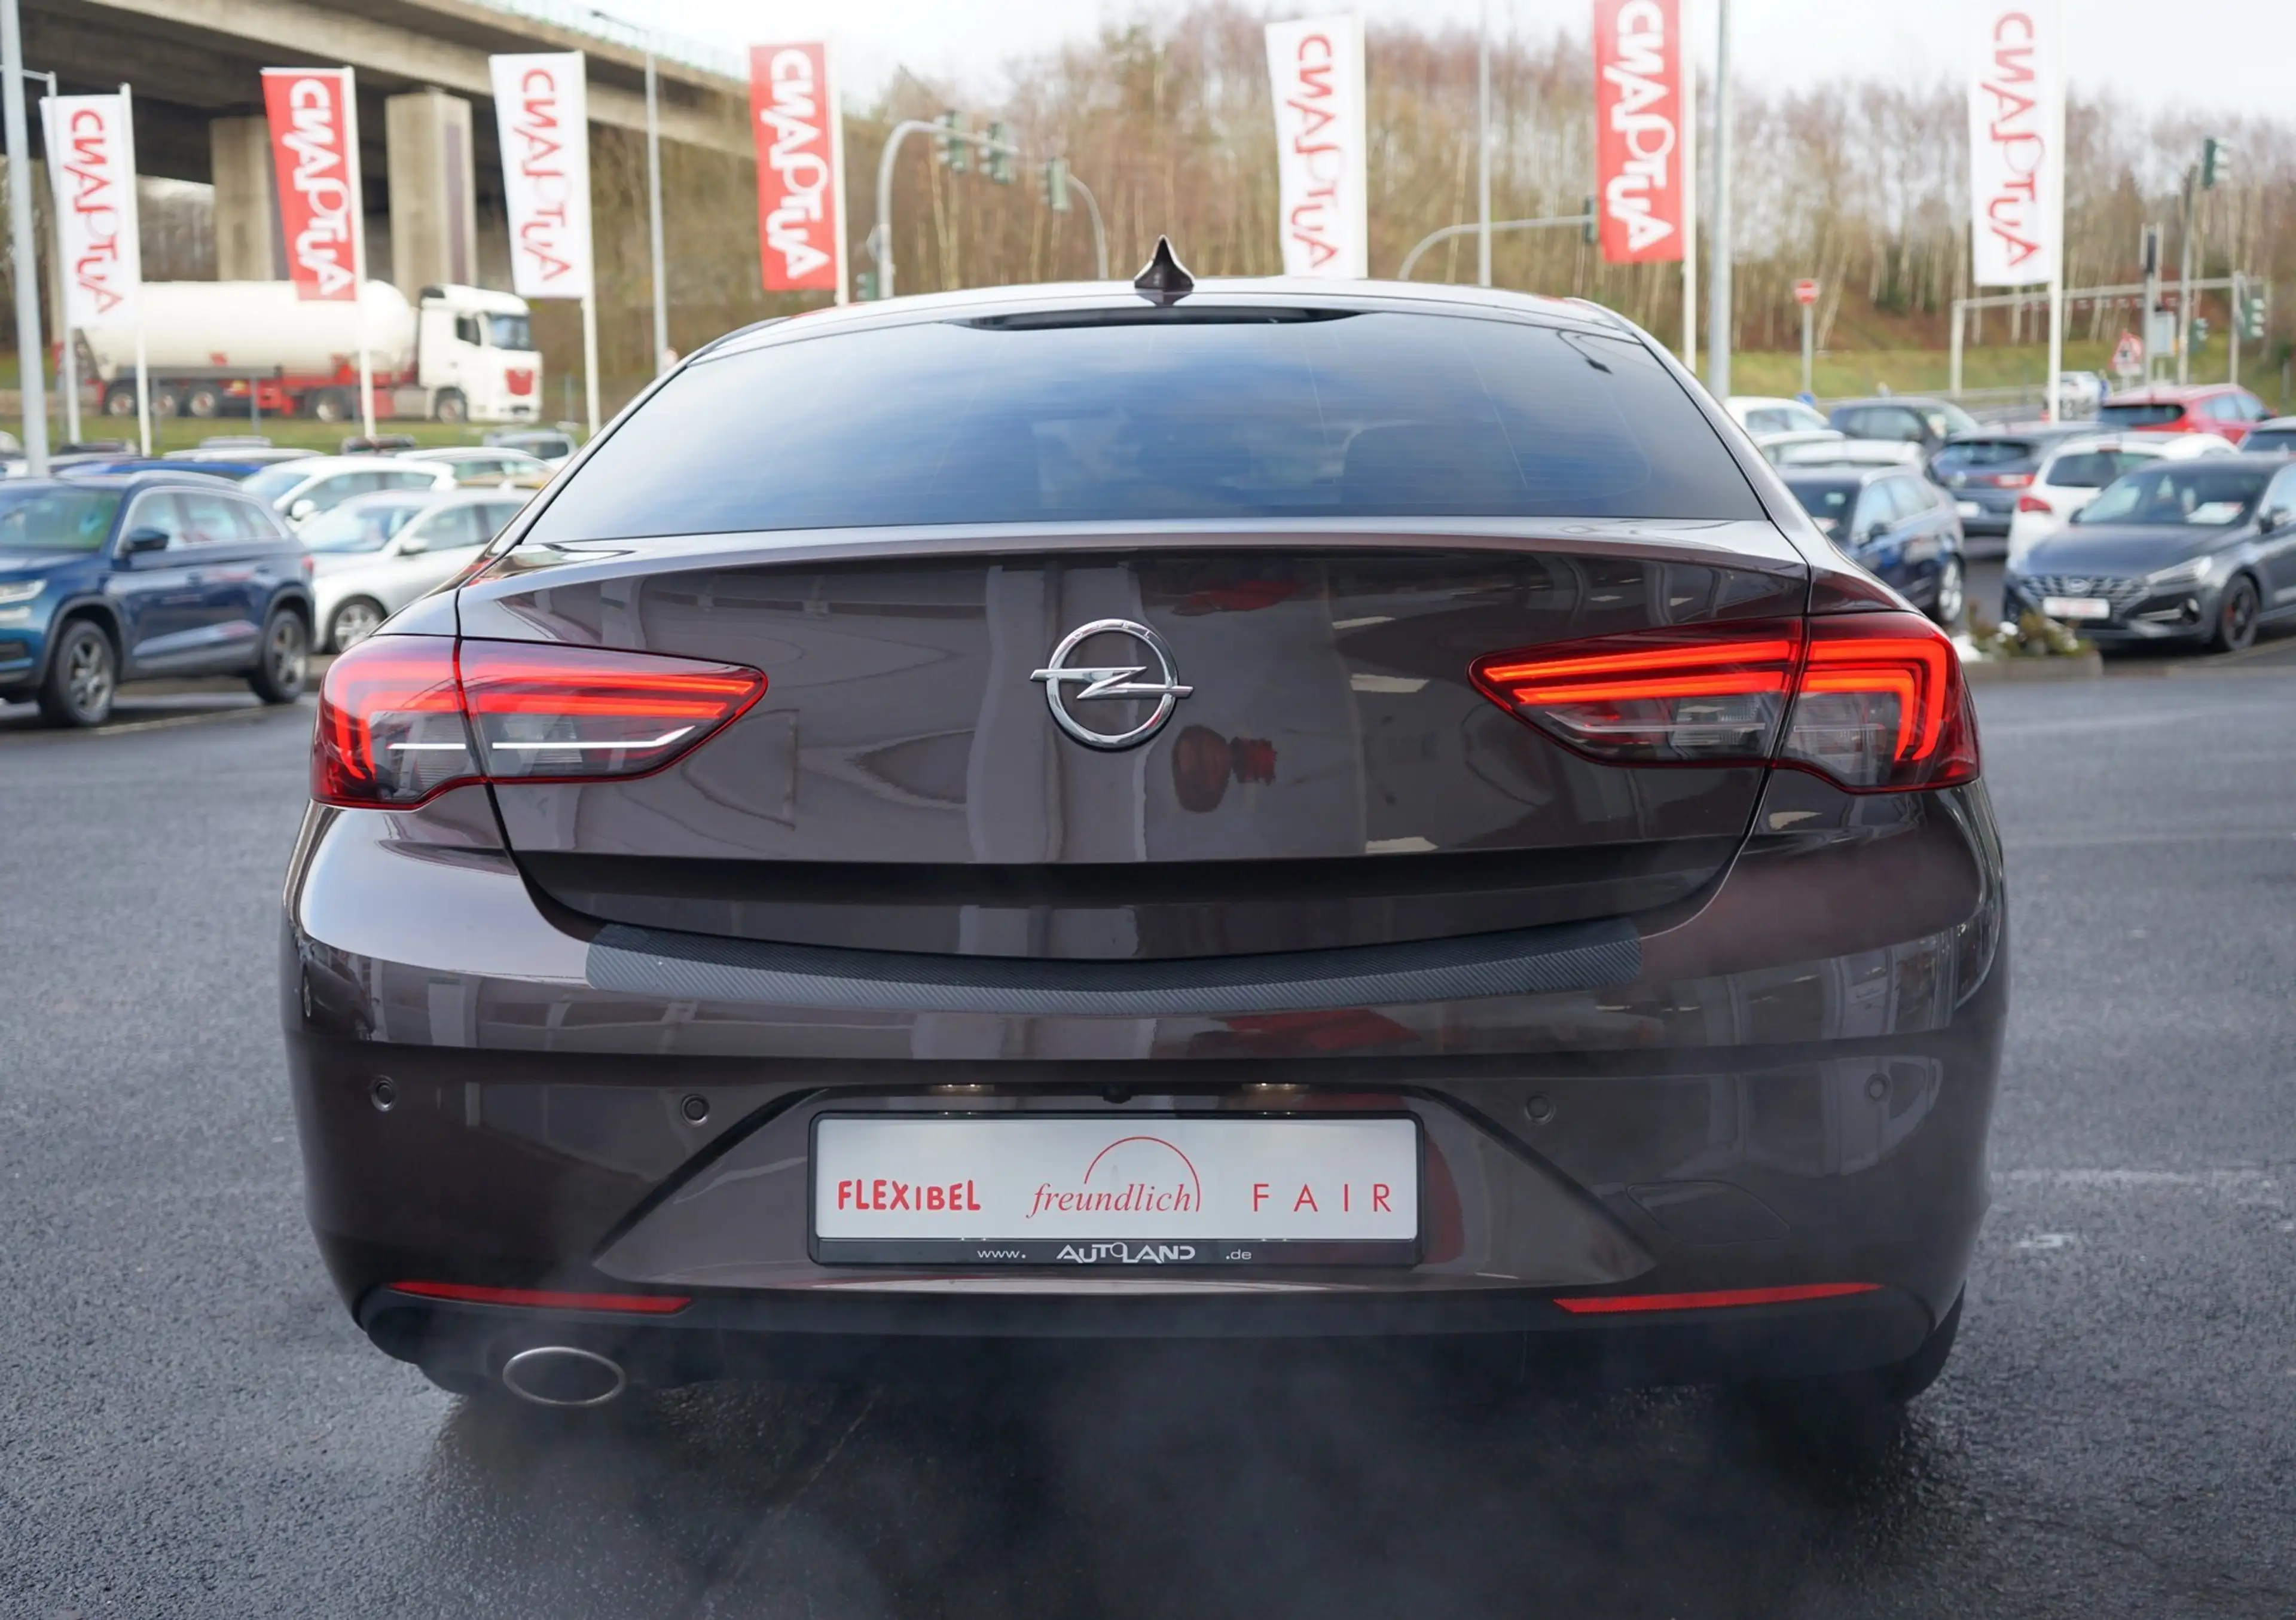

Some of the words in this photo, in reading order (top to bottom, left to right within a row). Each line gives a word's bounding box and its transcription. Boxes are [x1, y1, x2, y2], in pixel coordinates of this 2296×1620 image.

[838, 1179, 981, 1211] FLEXIBEL
[1027, 1184, 1191, 1218] freundlich
[1254, 1183, 1391, 1212] FAIR
[977, 1250, 1026, 1259] www.
[1056, 1242, 1196, 1264] AUTOLAND
[1226, 1249, 1252, 1260] .de
